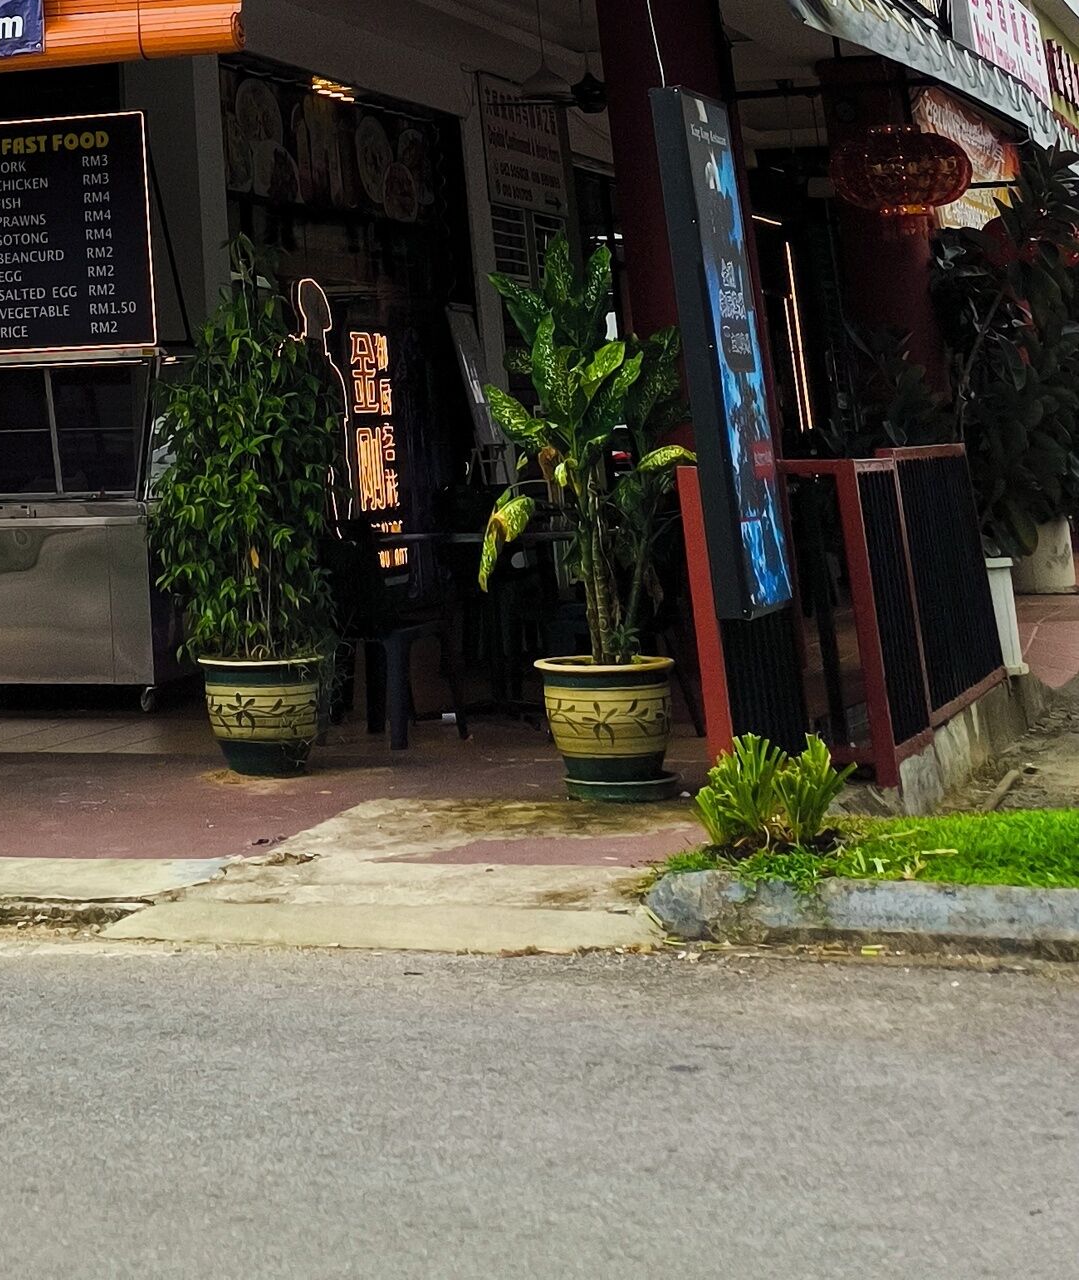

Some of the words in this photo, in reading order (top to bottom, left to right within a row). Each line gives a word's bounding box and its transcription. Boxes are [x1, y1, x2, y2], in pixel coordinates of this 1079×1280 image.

[1, 135, 48, 155] FAST
[52, 130, 110, 152] FOOD
[81, 154, 109, 168] RM3
[82, 172, 110, 186] RM3
[83, 191, 111, 205] RM4
[84, 209, 112, 223] RM4
[85, 228, 113, 242] RM4
[86, 246, 114, 260] RM2
[87, 264, 115, 278] RM2
[51, 285, 78, 299] EGG
[88, 283, 116, 297] RM2
[89, 300, 138, 316] RM1.50
[0, 325, 29, 339] RICE
[90, 321, 118, 335] RM2
